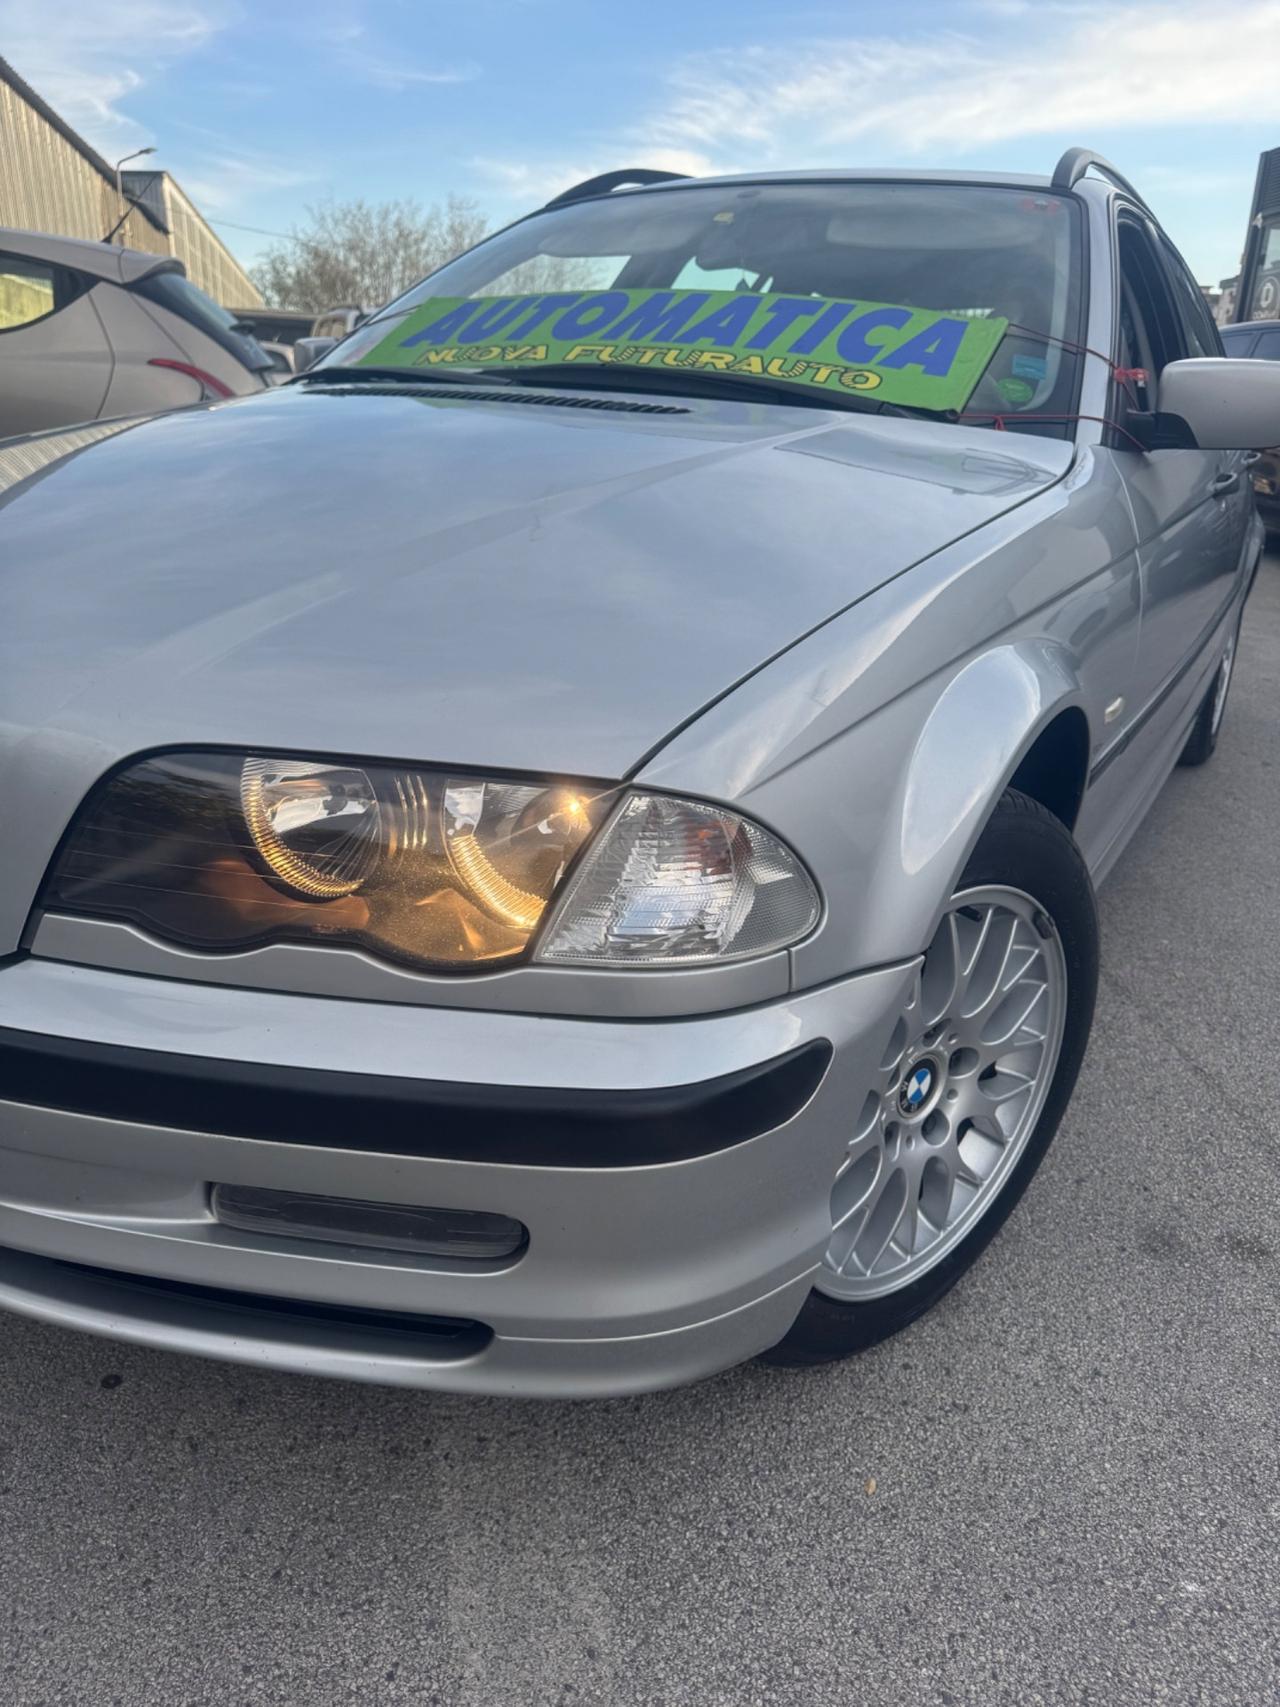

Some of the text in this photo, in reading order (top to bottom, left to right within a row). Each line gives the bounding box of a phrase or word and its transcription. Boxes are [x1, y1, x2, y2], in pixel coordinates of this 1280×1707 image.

[401, 291, 969, 377] AUTOMATICA
[413, 344, 883, 390] NUOVA FUTURAUTO
